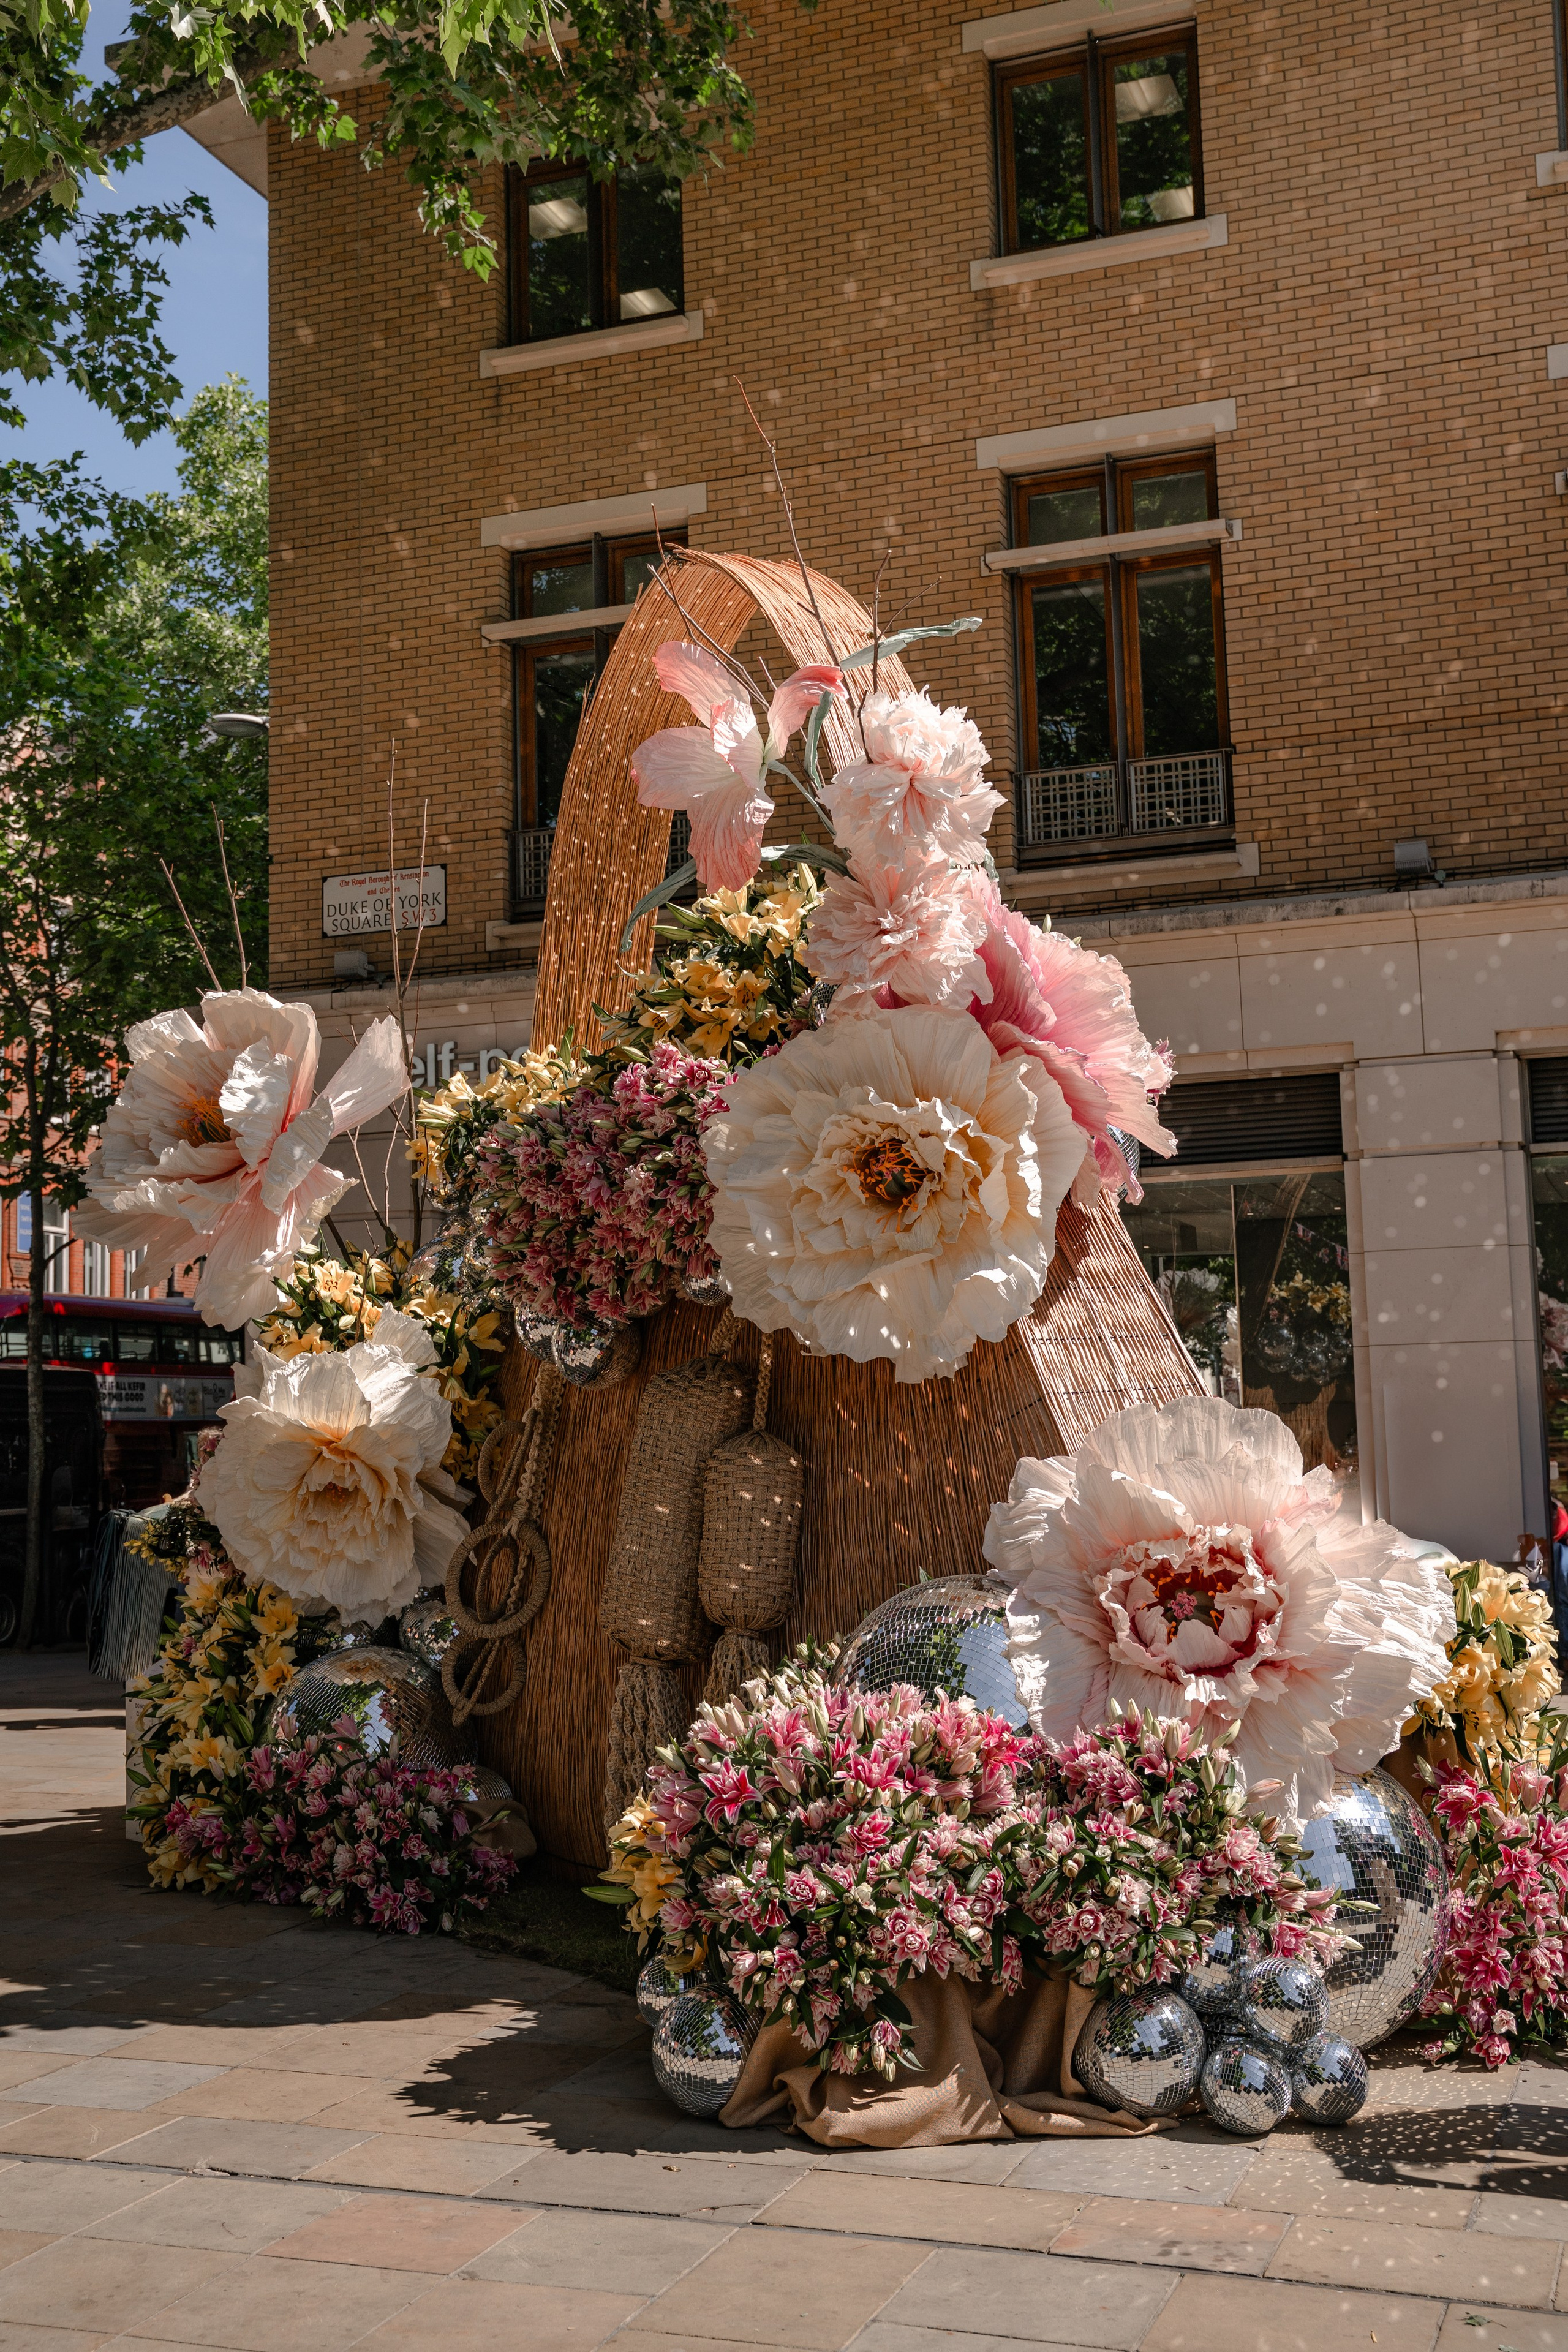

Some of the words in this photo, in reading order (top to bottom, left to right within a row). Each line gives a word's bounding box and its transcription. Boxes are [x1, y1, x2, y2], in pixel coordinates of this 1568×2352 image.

[351, 878, 366, 887] Royal
[369, 875, 390, 884] Borough
[400, 872, 429, 880] Kensingon
[327, 900, 368, 917] DUKE
[373, 898, 391, 912] OF
[399, 892, 442, 909] YORK
[332, 913, 391, 932] SQUARE
[402, 908, 437, 924] S.W.3
[124, 1392, 144, 1402] GOOD
